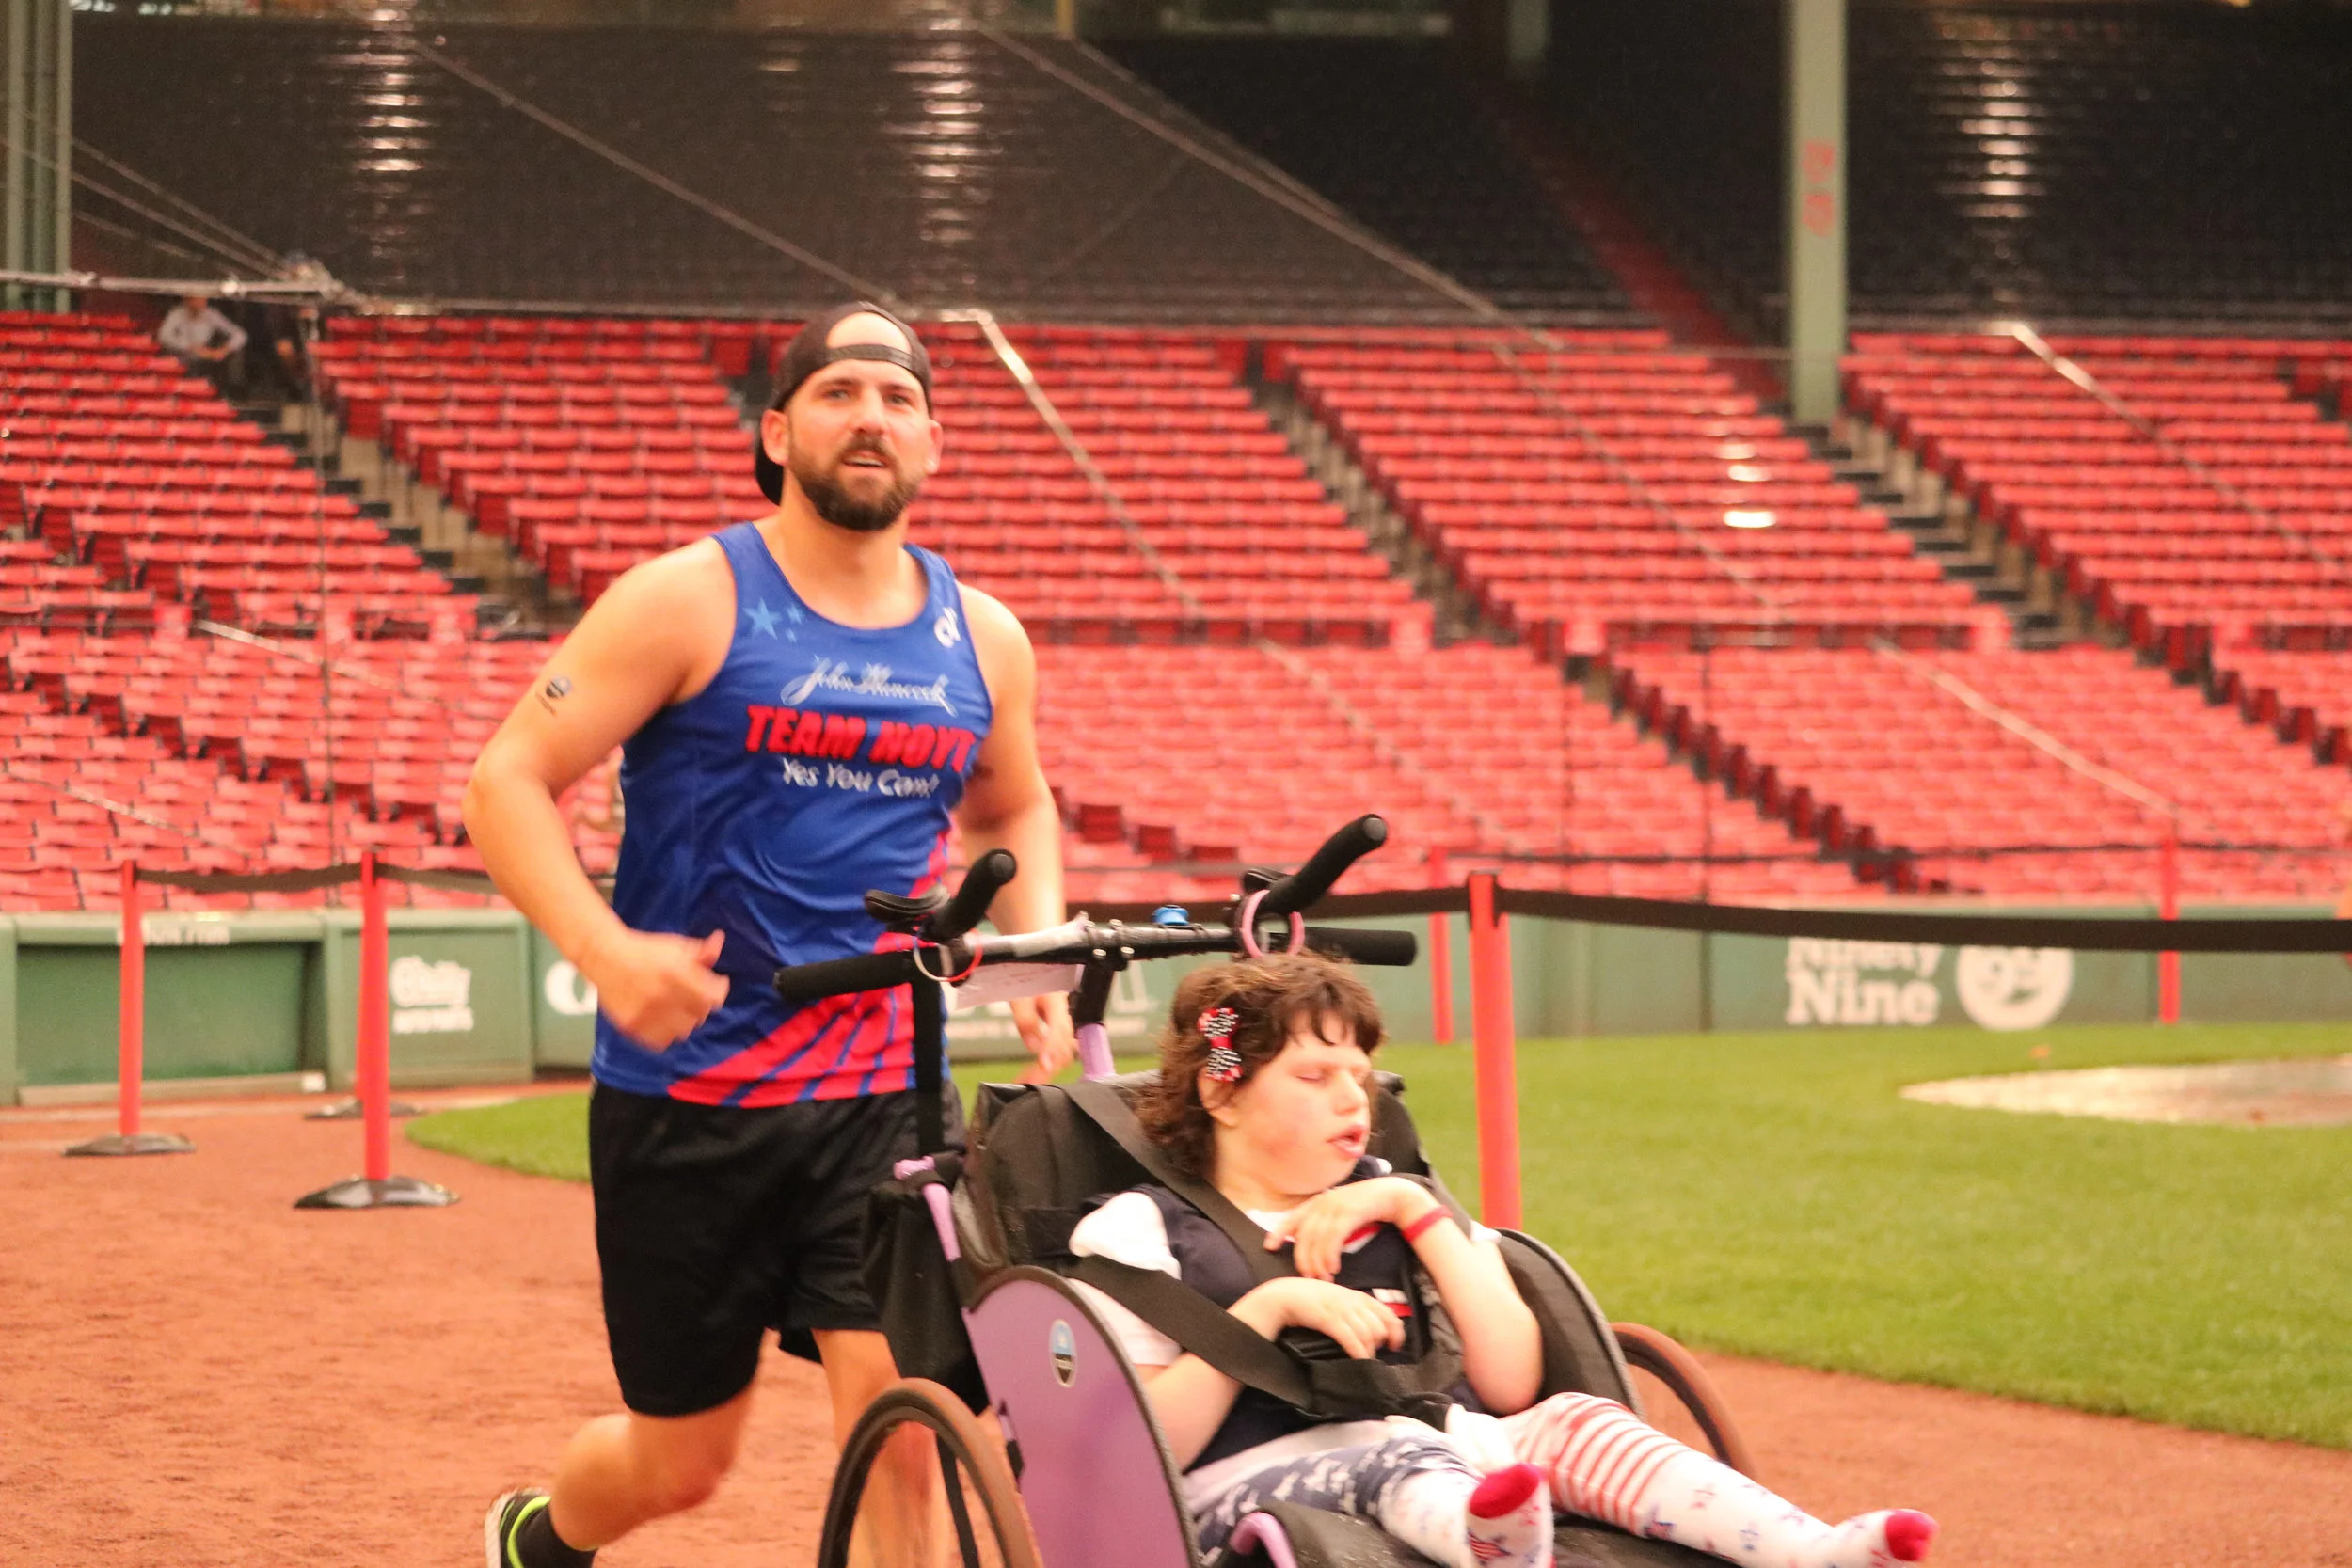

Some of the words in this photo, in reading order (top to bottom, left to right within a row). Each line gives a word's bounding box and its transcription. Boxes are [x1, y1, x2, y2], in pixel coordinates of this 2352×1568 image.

[746, 704, 867, 761] TEAM
[868, 720, 977, 774] HOYT
[782, 756, 820, 787] Yes
[826, 762, 874, 792] You
[1785, 968, 1941, 1026] Nine
